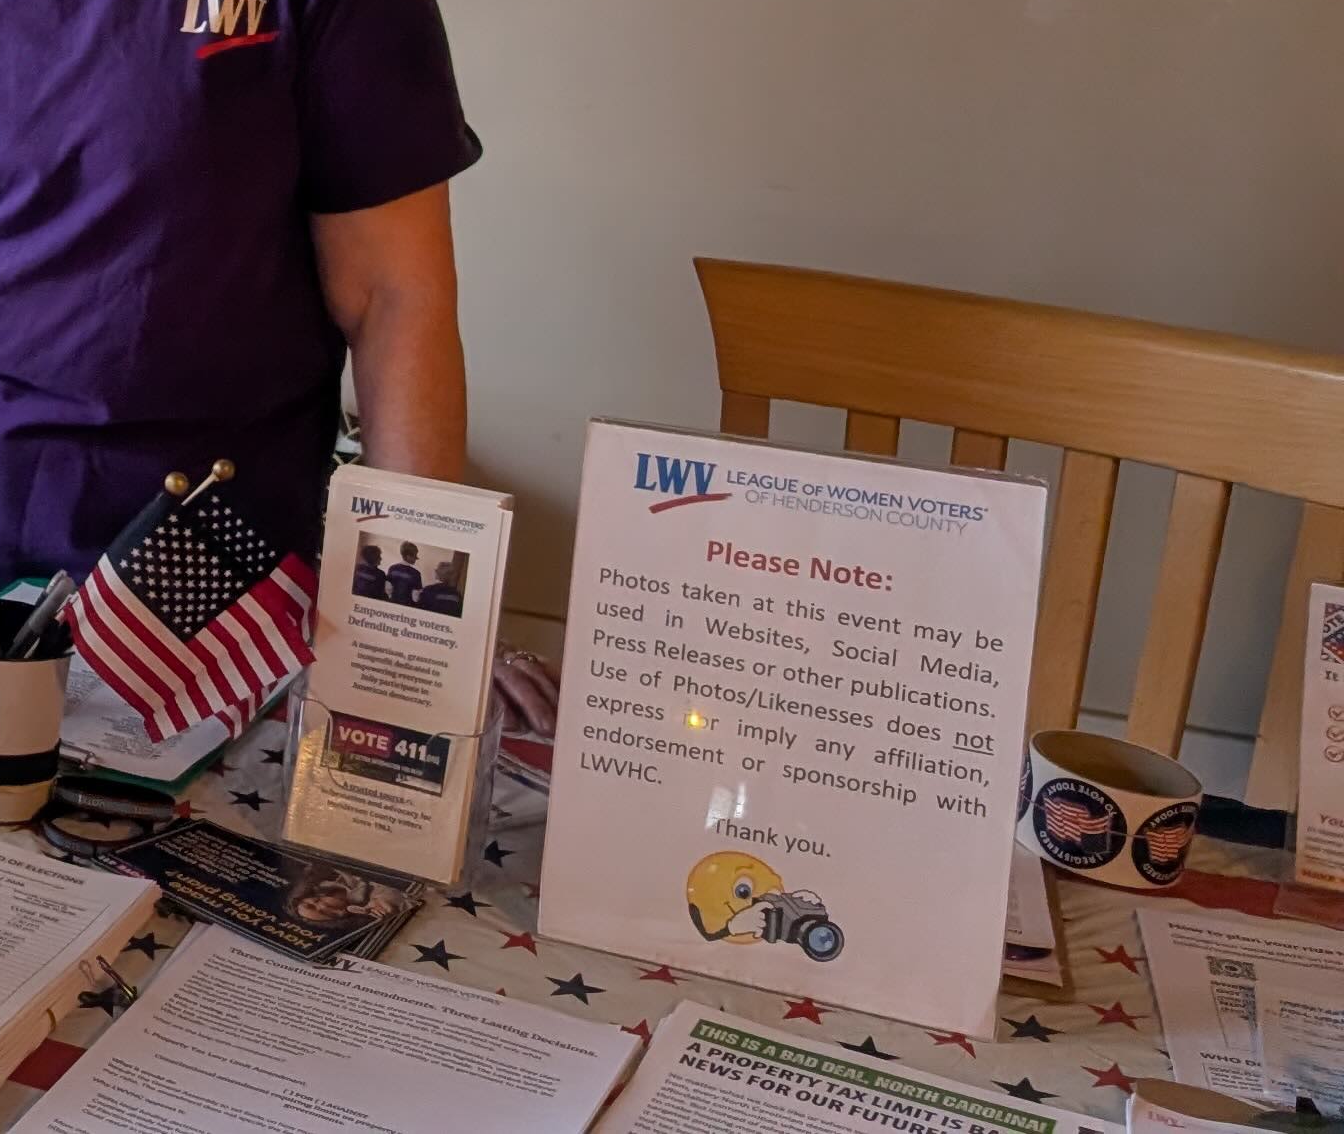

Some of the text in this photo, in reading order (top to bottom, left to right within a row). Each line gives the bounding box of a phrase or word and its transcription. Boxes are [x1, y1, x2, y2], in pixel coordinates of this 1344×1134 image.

[634, 453, 717, 496] LWV
[727, 469, 798, 494] LEAGUE
[802, 483, 824, 496] OF
[827, 484, 904, 509] WOMEN
[351, 497, 384, 516] LWV
[745, 489, 968, 537] OF HENDERSON COUNTY
[708, 540, 893, 592] Please Note:
[348, 615, 458, 649] Defending democracy.
[352, 604, 453, 634] Empowering voters.
[599, 568, 1004, 653] Photos taken at this event may be
[596, 600, 1000, 688] used in Websites, Social Media,
[593, 629, 996, 719] Press Releases or other publications.
[590, 659, 627, 683] Use
[639, 668, 662, 689] of
[673, 675, 874, 730] Photos/Likenesses
[886, 716, 941, 743] does
[954, 729, 994, 754] not
[339, 726, 427, 762] VOTE 411
[586, 694, 665, 723] express
[737, 719, 798, 750] imply
[815, 736, 855, 761] any
[873, 746, 990, 788] affiliation,
[580, 752, 662, 785] LWVHC.
[583, 722, 987, 818] endorsement or sponsorship with
[714, 817, 832, 858] Thank you.
[7, 857, 23, 868] OF
[22, 862, 85, 885] ELECTIONS
[223, 907, 262, 925] you
[262, 925, 313, 949] Have
[229, 946, 598, 1058] Three Constitutional Amendments. Three Lasting Decisions.
[679, 1054, 743, 1081] NEWS
[746, 1074, 792, 1097] FOR
[795, 1090, 845, 1113] OUR
[686, 1042, 701, 1053] A
[706, 1048, 823, 1088] PROPERTY
[826, 1081, 868, 1102] TAX
[871, 1096, 939, 1122] LIMIT
[941, 1115, 963, 1130] IS
[699, 1025, 740, 1045] THIS
[741, 1038, 762, 1051] IS
[763, 1046, 777, 1056] A
[780, 1050, 819, 1068] BAD
[875, 1076, 941, 1102] NORTH
[943, 1096, 1049, 1133] CAROLINA!
